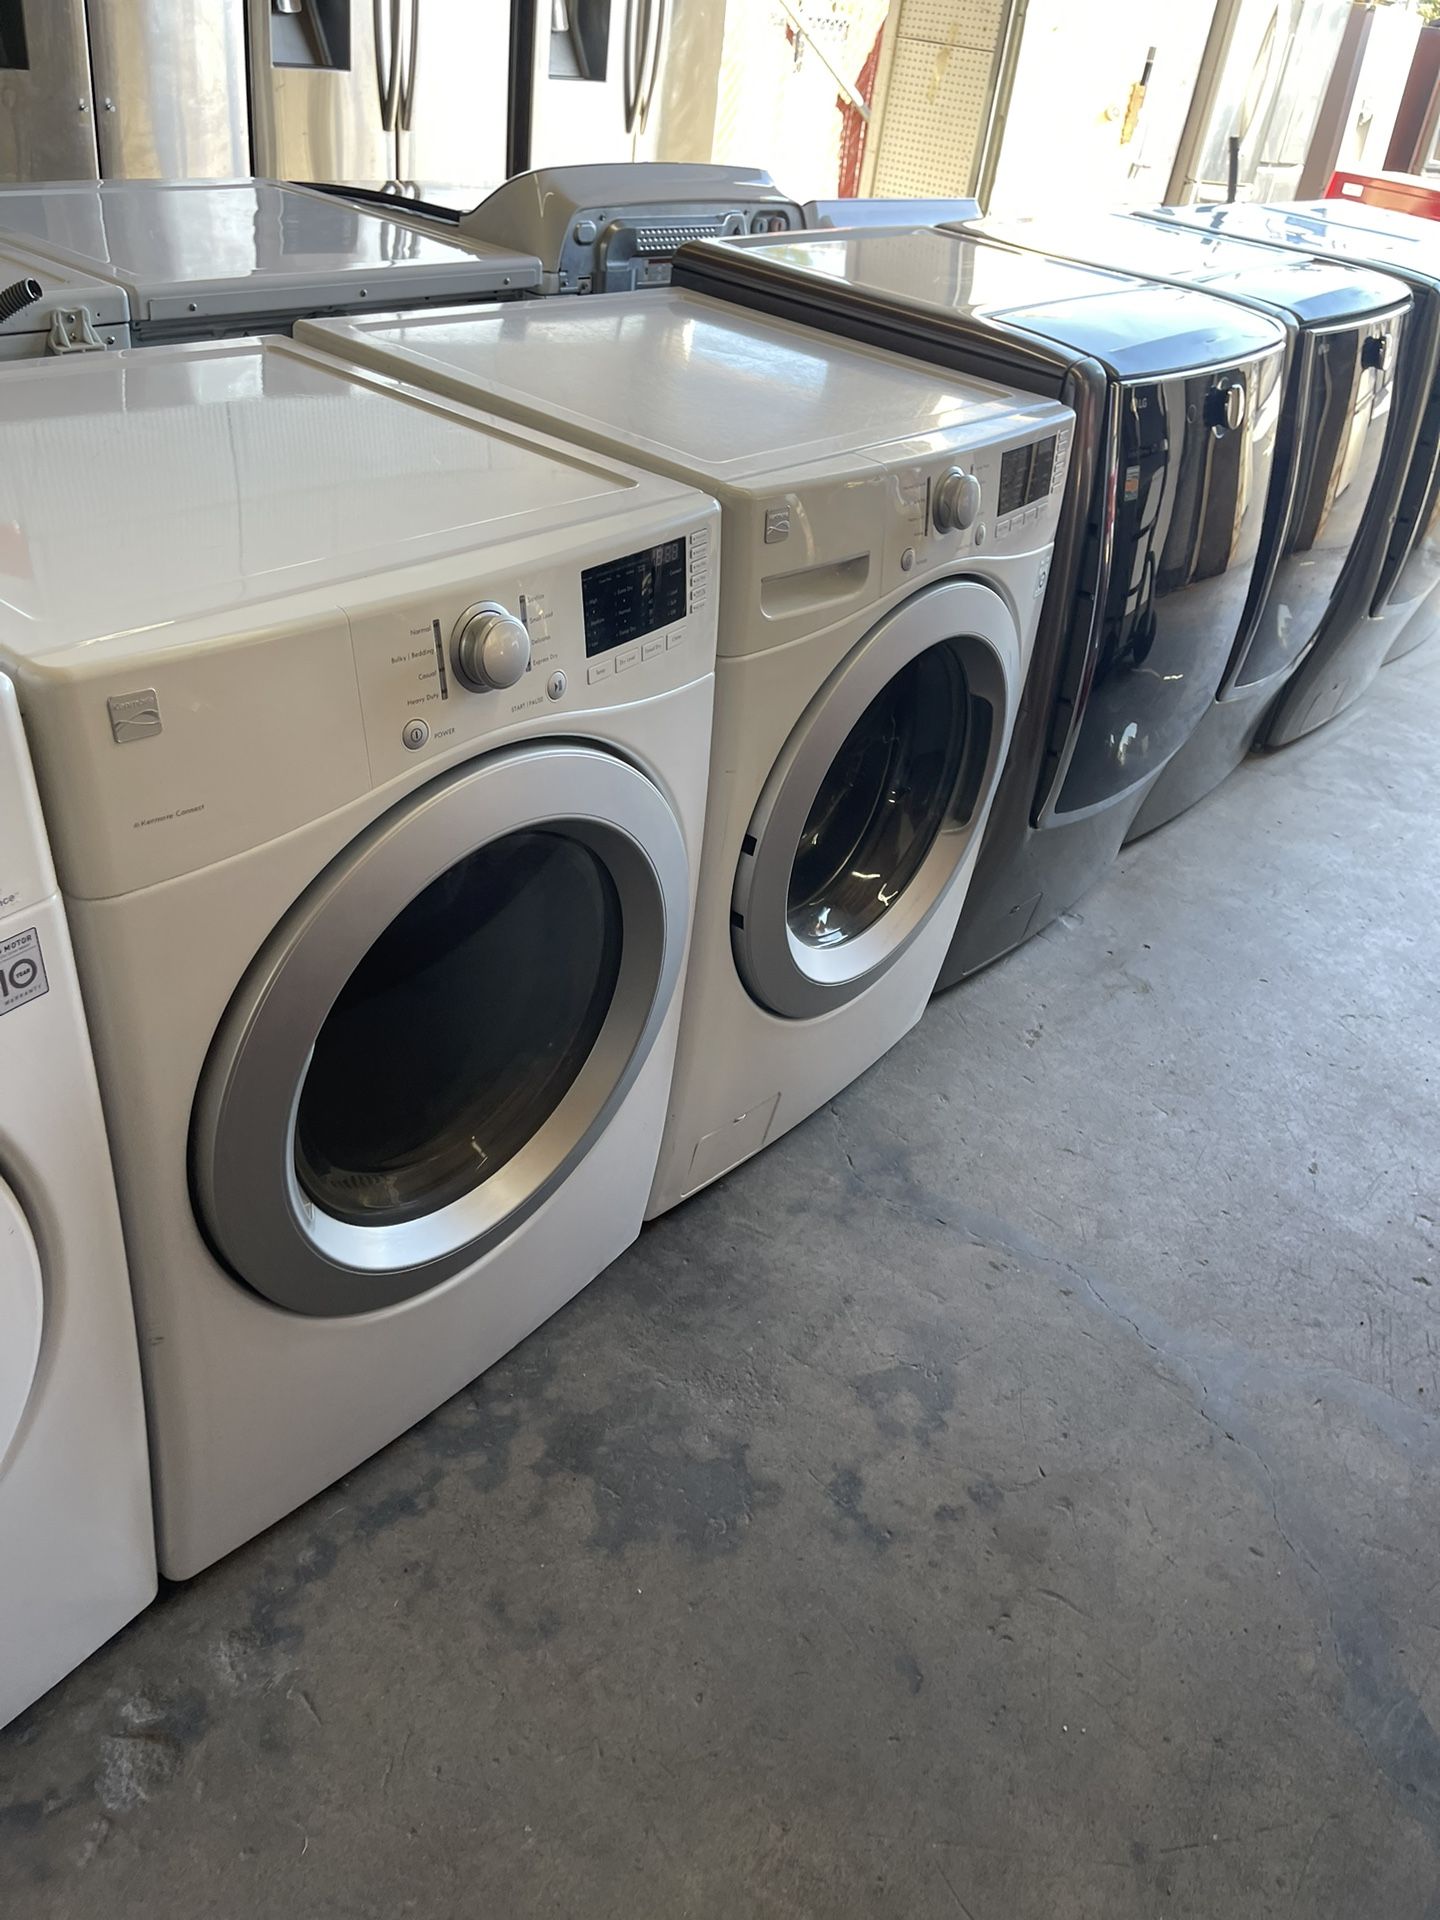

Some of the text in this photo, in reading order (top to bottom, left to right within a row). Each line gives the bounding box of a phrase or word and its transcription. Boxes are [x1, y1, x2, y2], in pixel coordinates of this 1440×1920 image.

[410, 625, 432, 635] Normal
[418, 670, 436, 680] Casual
[407, 698, 425, 706] Heavy
[511, 702, 526, 713] START
[434, 728, 455, 739] POWER
[141, 804, 204, 826] Kenmore Connect
[4, 934, 32, 951] MOTOR
[0, 958, 37, 997] 10
[16, 968, 31, 979] YEAR
[5, 984, 42, 1005] WARRANTY
